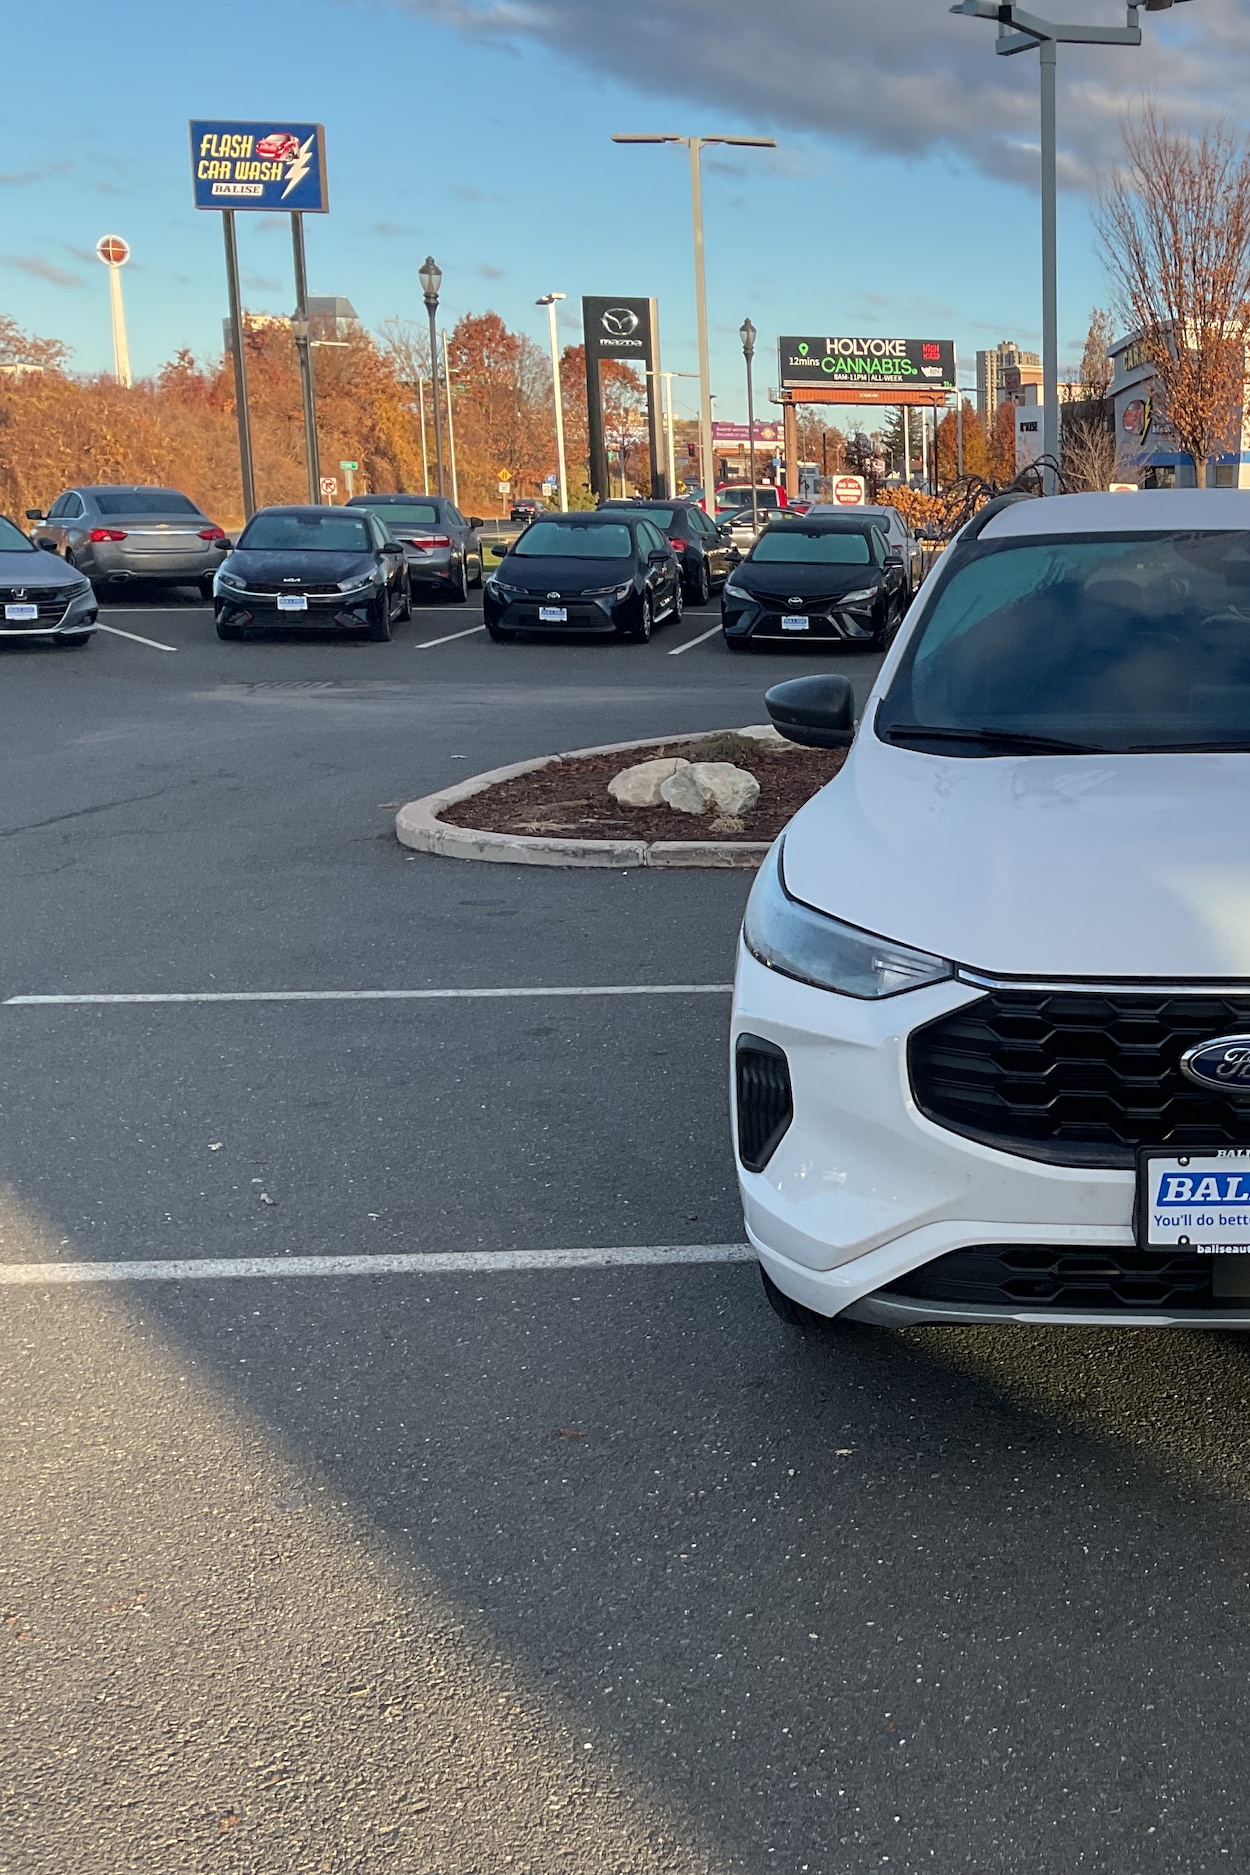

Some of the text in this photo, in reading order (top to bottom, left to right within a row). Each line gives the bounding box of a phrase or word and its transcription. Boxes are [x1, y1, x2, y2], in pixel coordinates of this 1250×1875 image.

[200, 134, 253, 158] FLASH
[198, 160, 282, 180] CAR WASH
[215, 185, 260, 193] BALISE
[826, 338, 906, 356] HOLYOKE
[789, 357, 820, 367] 12mins
[1122, 347, 1140, 371] CAR
[1154, 1215, 1192, 1226] You'll
[1196, 1214, 1214, 1226] do
